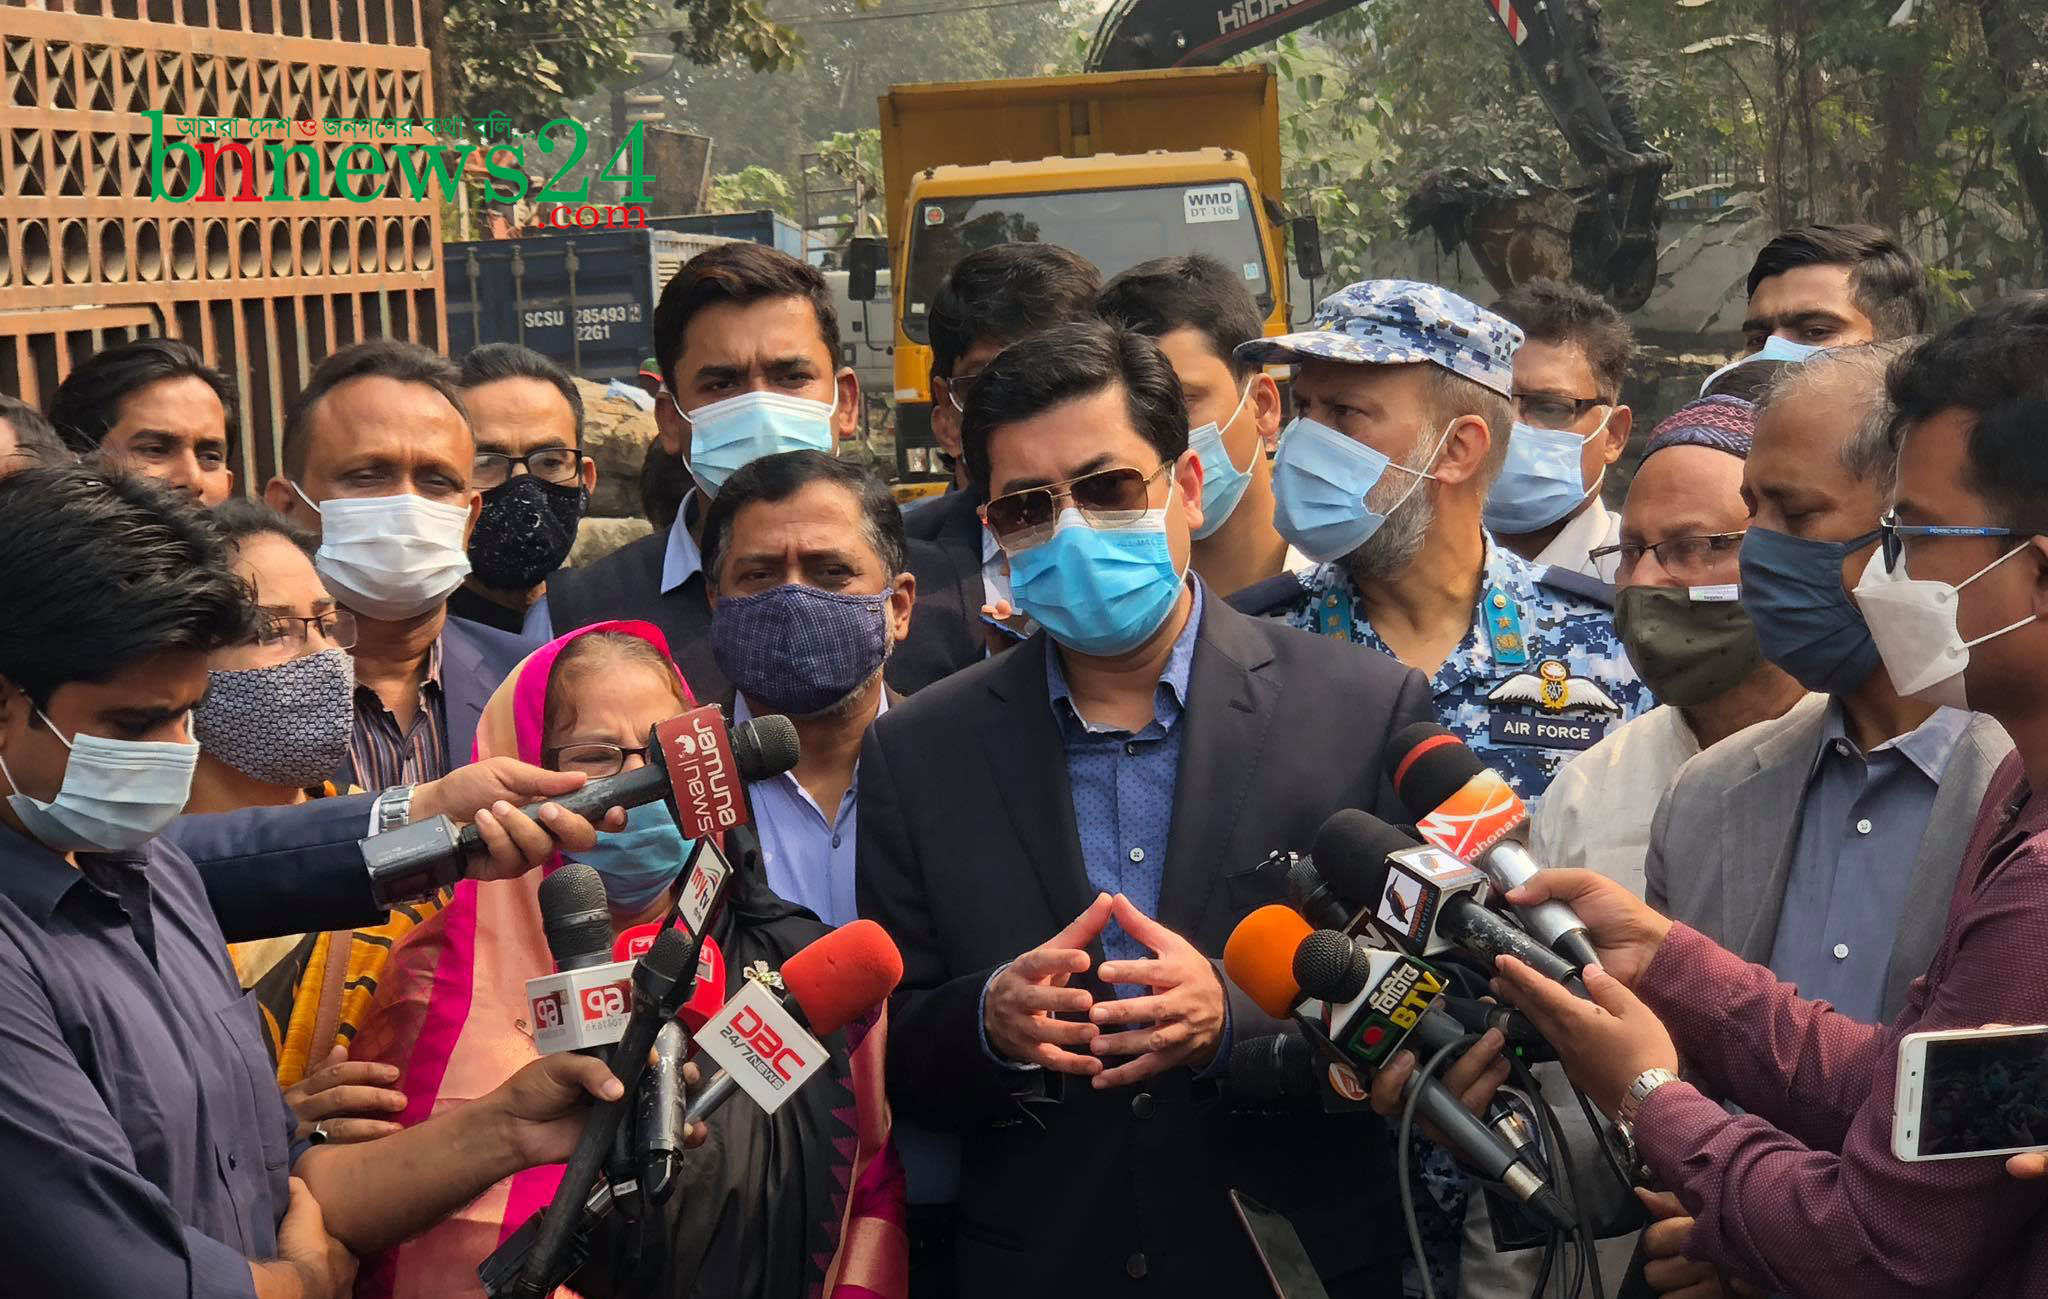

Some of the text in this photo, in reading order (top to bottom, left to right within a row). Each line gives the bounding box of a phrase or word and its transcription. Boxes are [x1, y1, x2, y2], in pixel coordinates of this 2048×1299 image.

[1188, 192, 1232, 206] WMD
[525, 310, 564, 328] SCSU
[576, 306, 626, 324] 285493
[576, 325, 610, 341] 22G1
[1503, 720, 1591, 740] AIR FORCE
[684, 764, 714, 831] news
[1390, 970, 1441, 1030] BTV
[729, 1004, 806, 1082] DBC
